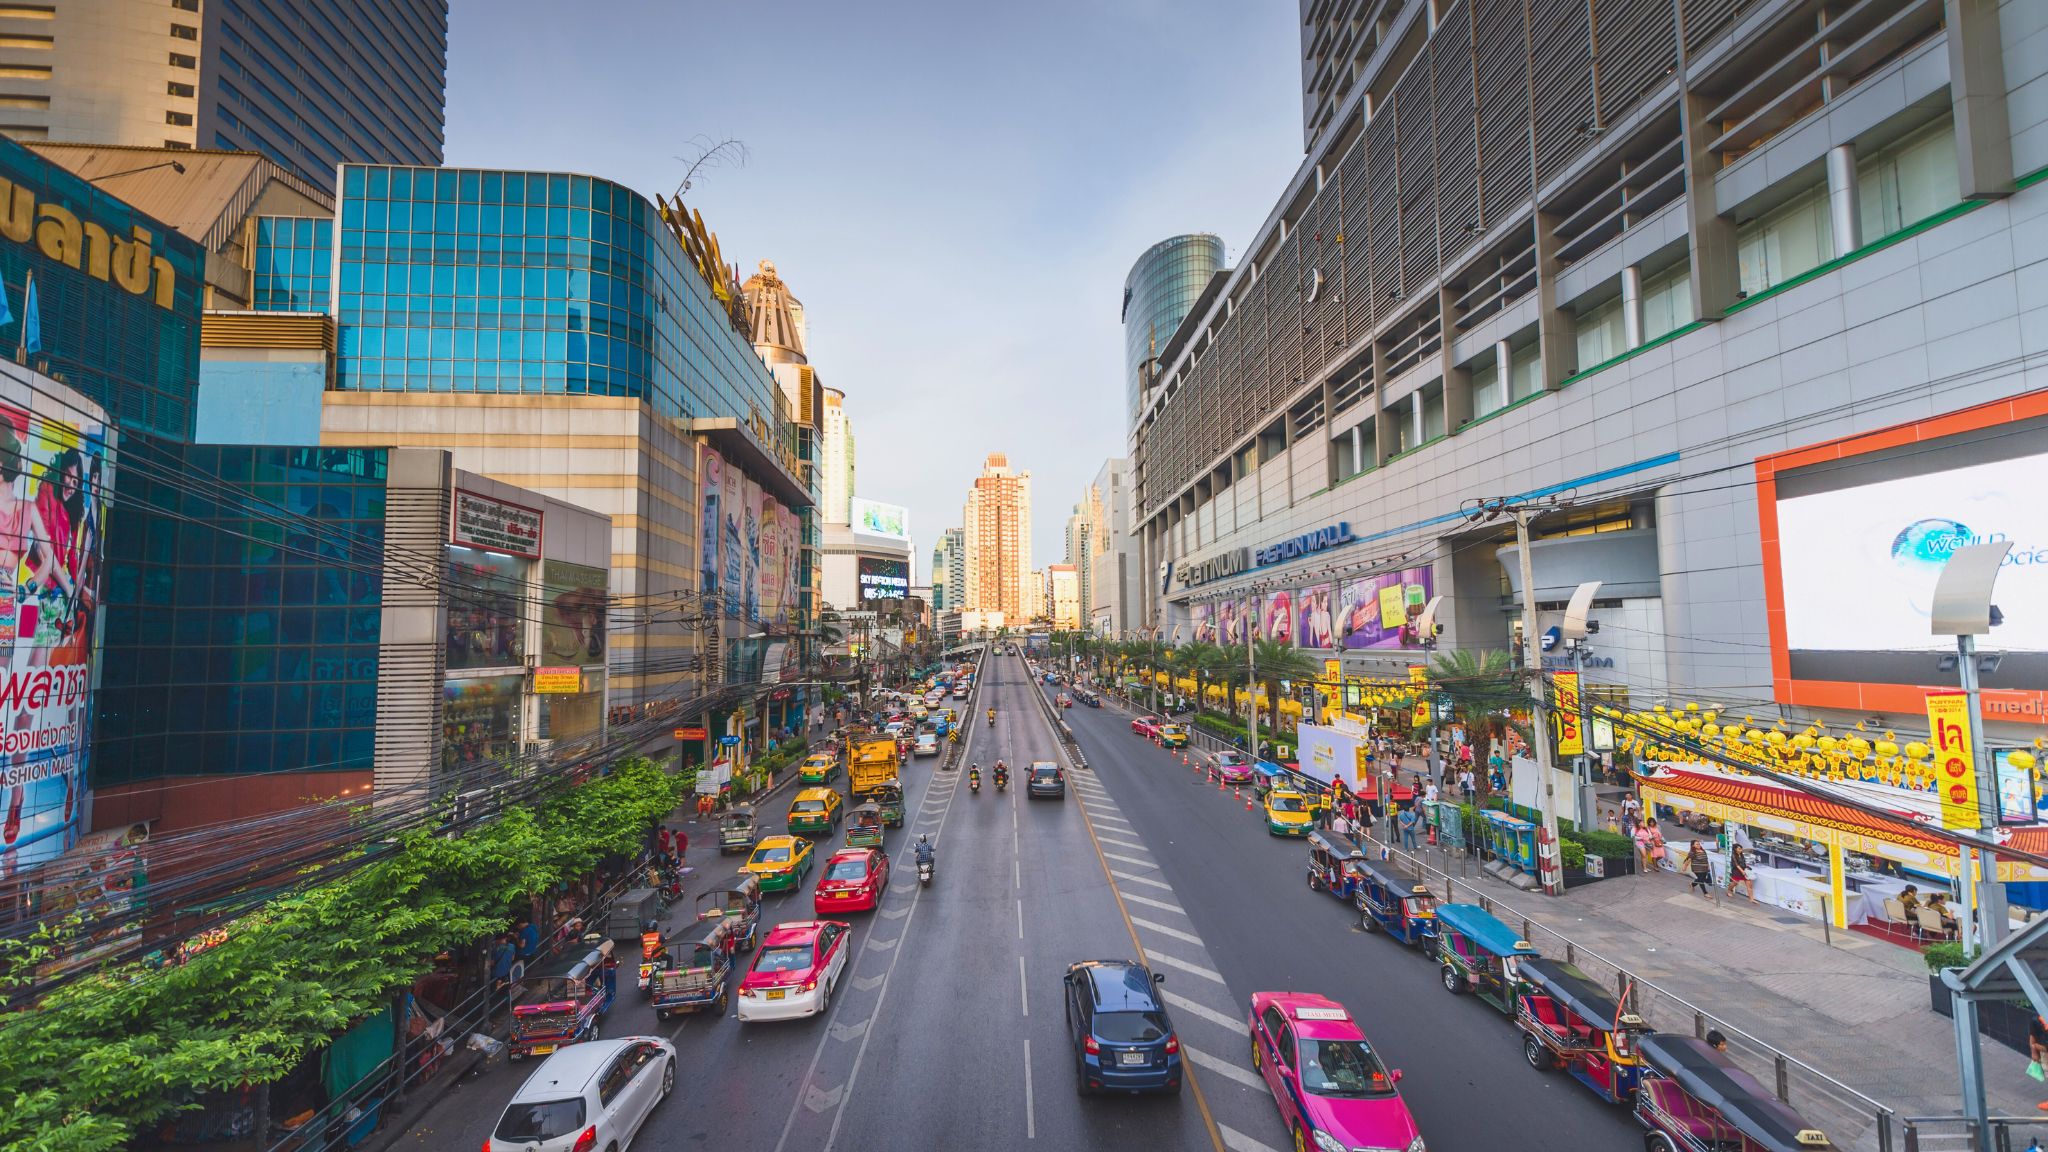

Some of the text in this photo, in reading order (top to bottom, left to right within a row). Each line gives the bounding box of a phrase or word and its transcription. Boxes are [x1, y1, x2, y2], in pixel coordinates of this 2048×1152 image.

[1256, 535, 1304, 567] FASHION
[1307, 522, 1350, 551] MALL
[51, 754, 74, 776] MALL
[1805, 1133, 1823, 1141] TAXI
